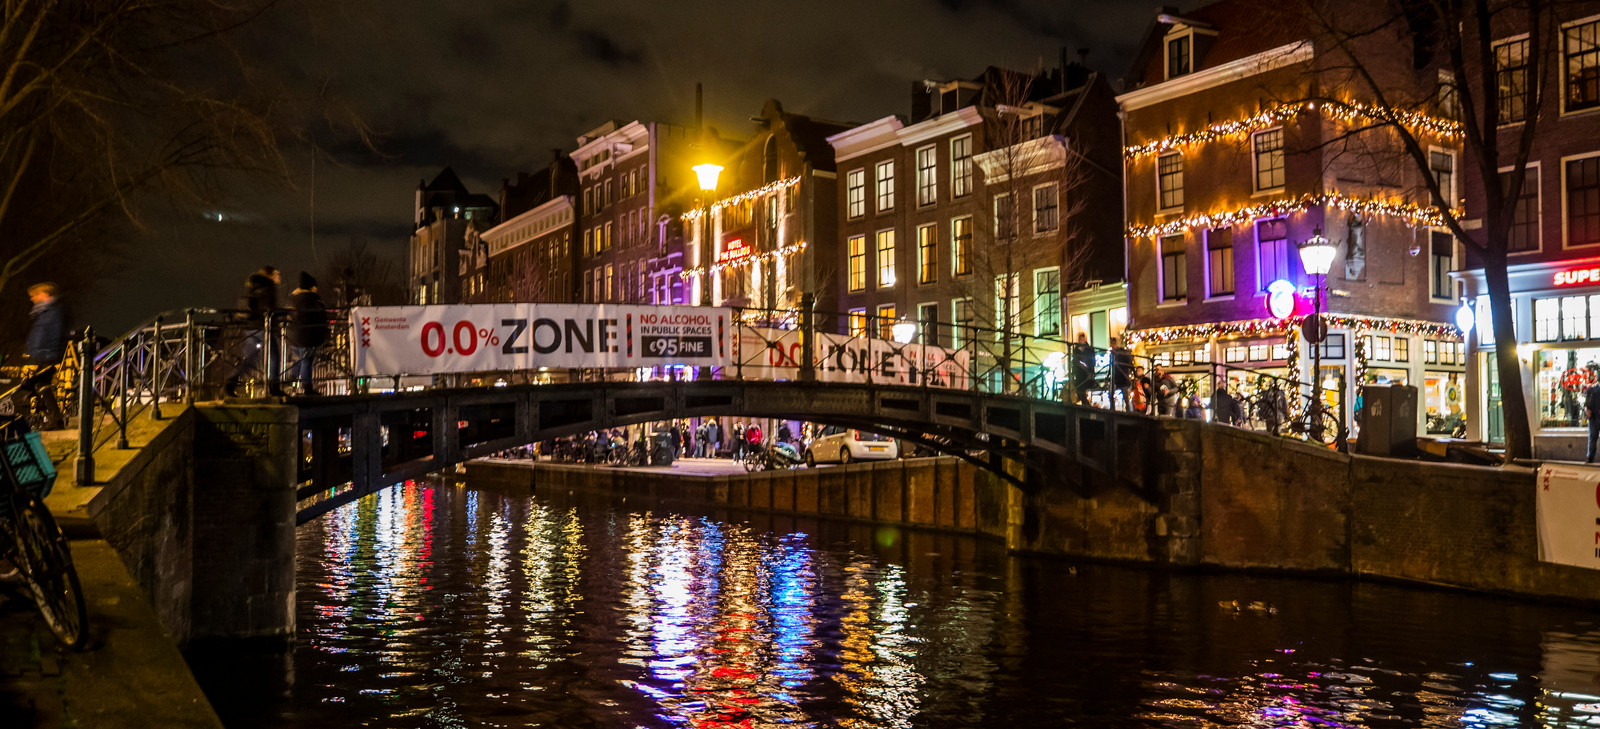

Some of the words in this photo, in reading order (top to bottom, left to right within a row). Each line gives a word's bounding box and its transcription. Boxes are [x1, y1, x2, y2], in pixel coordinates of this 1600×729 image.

[720, 251, 729, 261] THE
[729, 245, 751, 260] BULLDOG
[727, 239, 742, 251] HOTEL
[1553, 268, 1600, 285] SUPE
[640, 314, 658, 325] NO
[660, 314, 712, 325] ALCOHOL
[420, 320, 500, 358] 0.0%
[501, 317, 619, 355] ZONE
[640, 326, 650, 334] IN
[651, 326, 681, 335] PUBLIC
[682, 326, 712, 335] SPACES
[649, 338, 678, 355] €95
[680, 341, 704, 352] FINE
